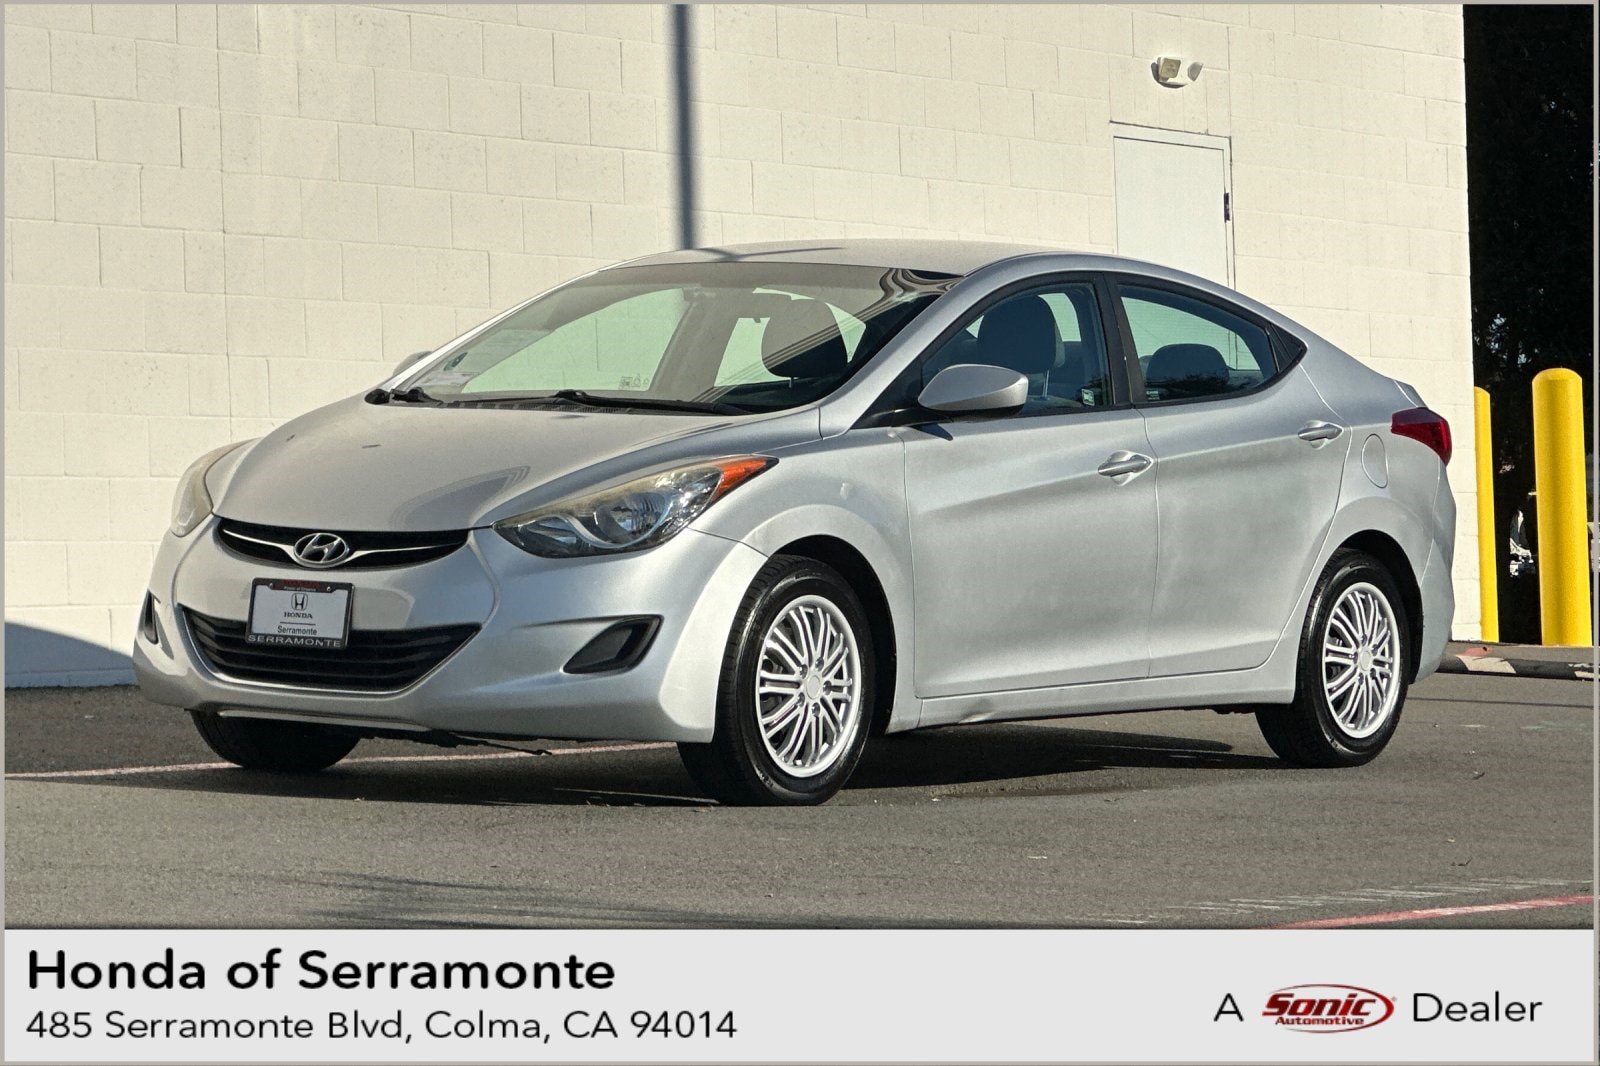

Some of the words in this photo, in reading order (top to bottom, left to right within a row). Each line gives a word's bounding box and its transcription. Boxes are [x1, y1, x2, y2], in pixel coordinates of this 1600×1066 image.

[284, 611, 313, 619] HONDA
[277, 625, 317, 636] Serramonte
[248, 635, 341, 648] SERRAMONTE
